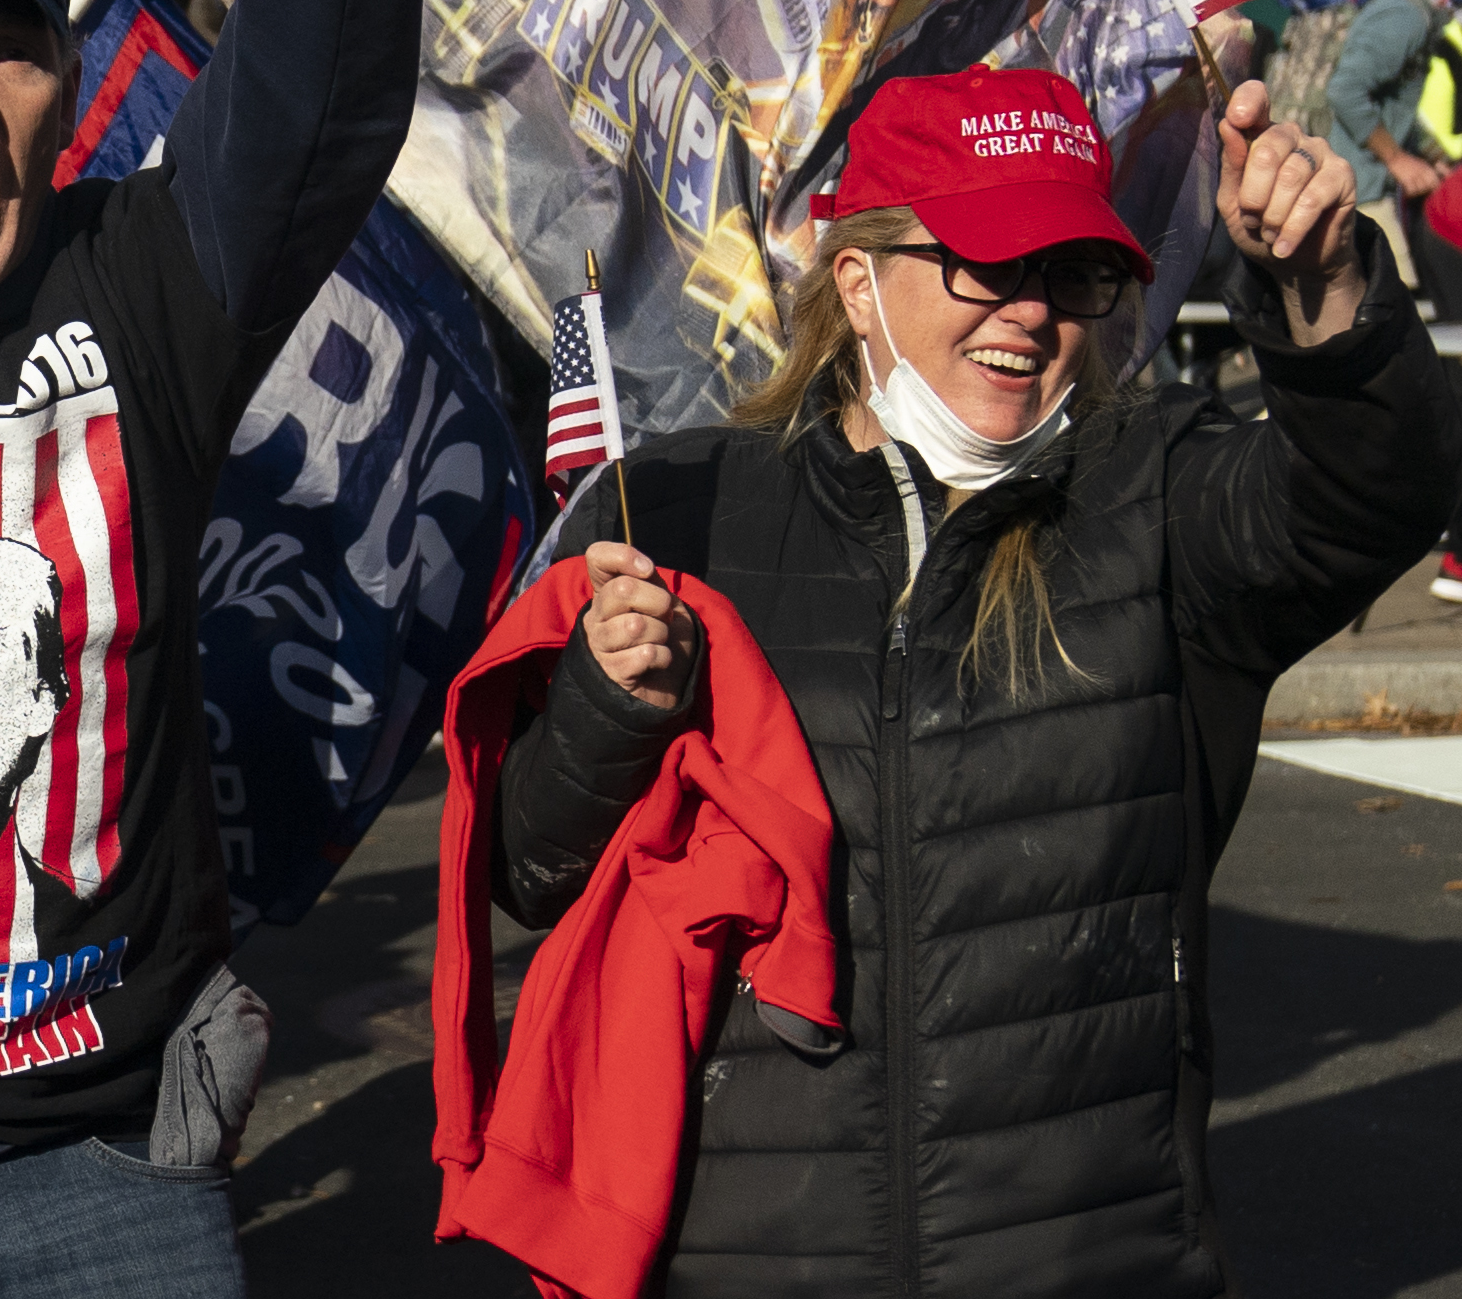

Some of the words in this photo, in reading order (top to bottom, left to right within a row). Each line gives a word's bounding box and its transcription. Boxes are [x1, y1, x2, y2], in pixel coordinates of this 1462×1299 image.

[961, 110, 1024, 137] MAKE
[1030, 109, 1097, 144] AMERICA
[974, 133, 1044, 158] GREAT
